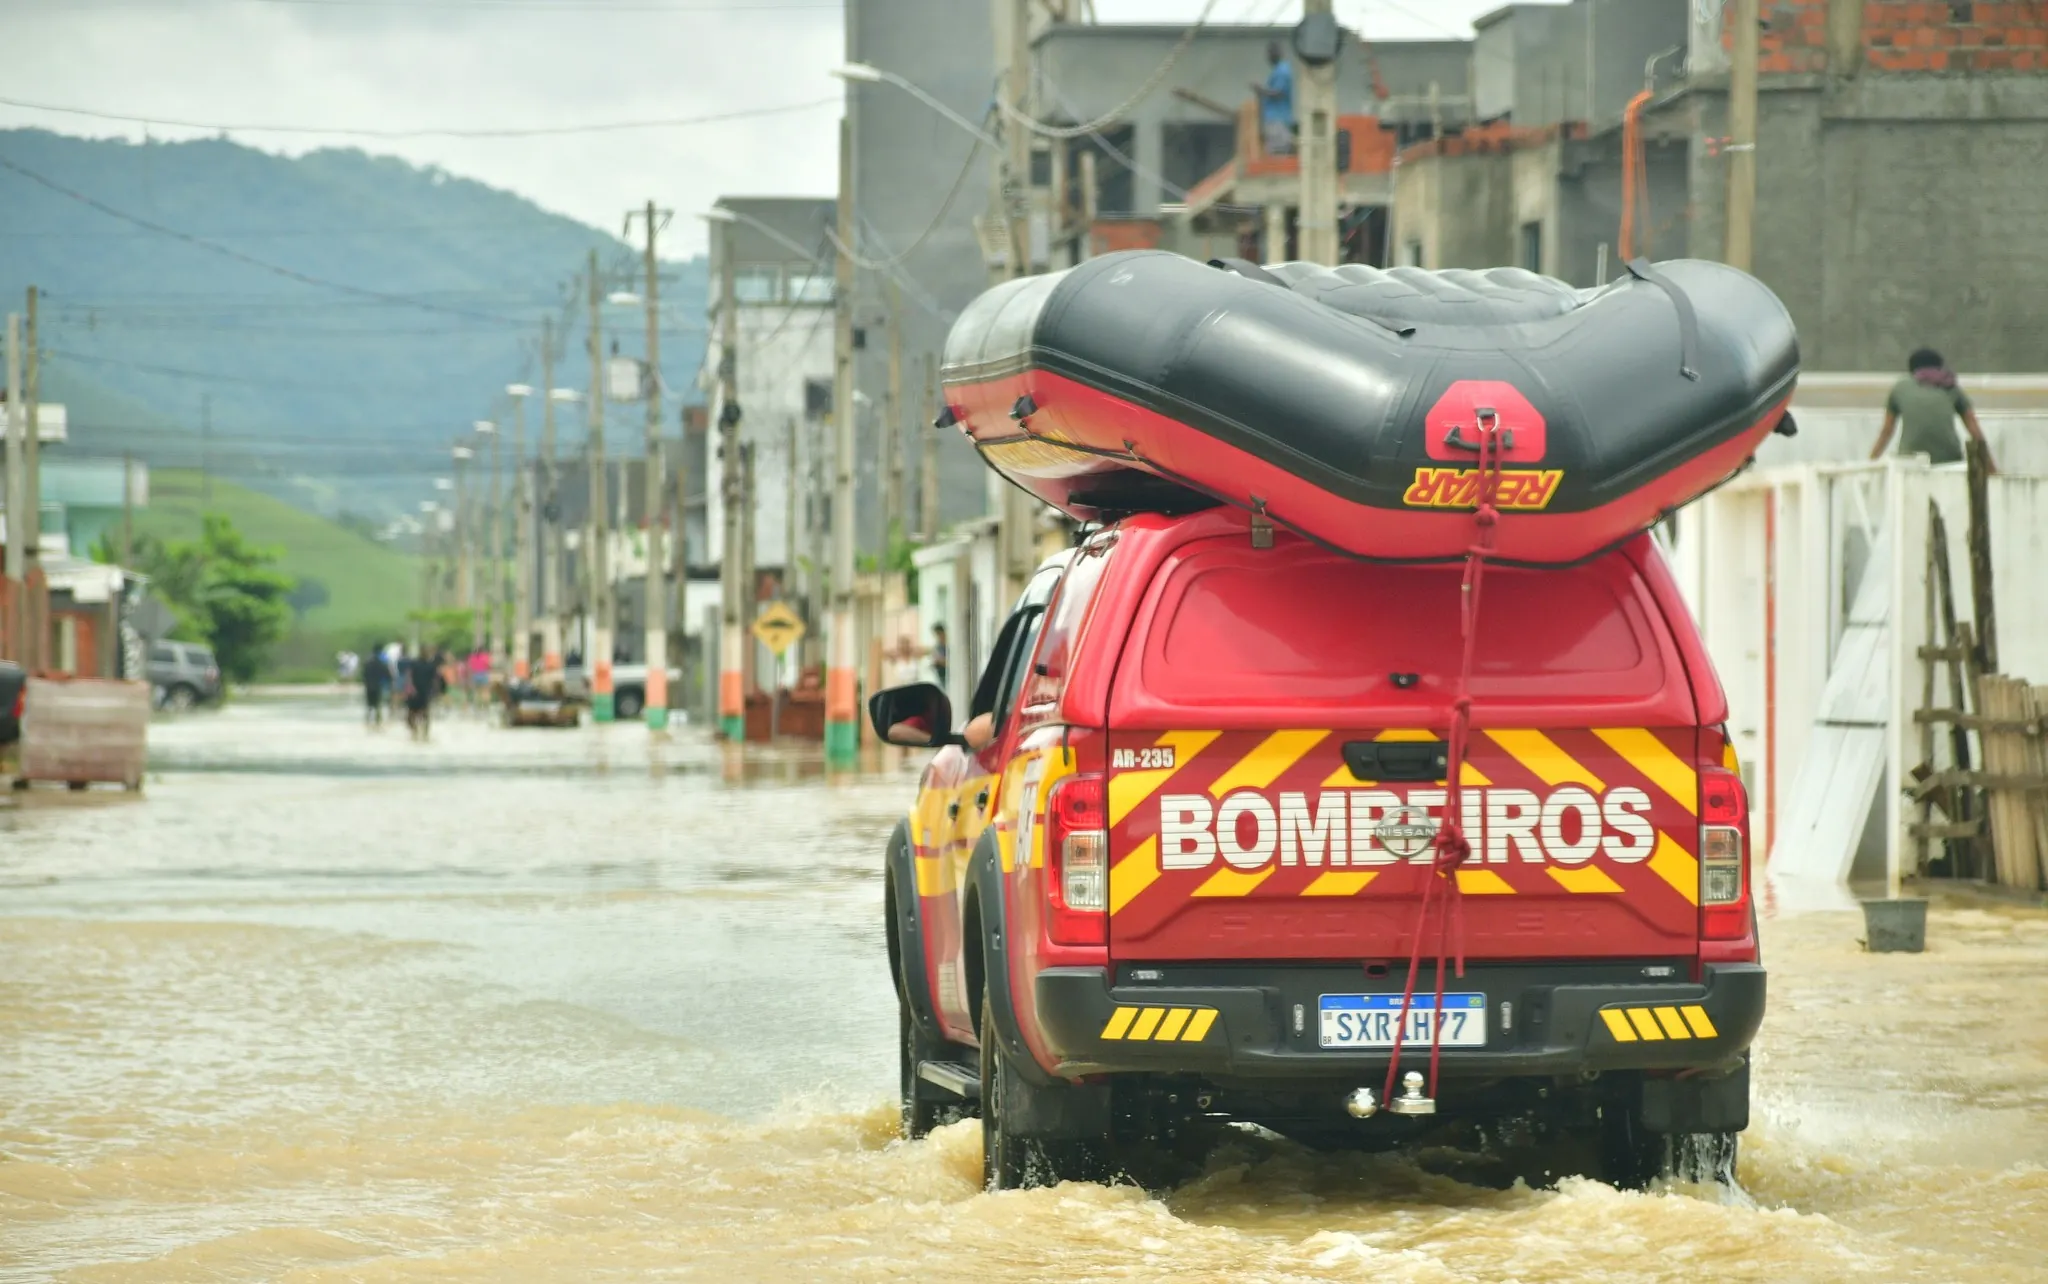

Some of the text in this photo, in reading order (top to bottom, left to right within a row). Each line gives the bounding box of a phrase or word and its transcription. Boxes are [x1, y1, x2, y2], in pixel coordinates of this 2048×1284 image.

[1112, 748, 1174, 768] AR-235
[1160, 786, 1654, 869] BOMBEIROS
[1375, 827, 1436, 837] NISSAN
